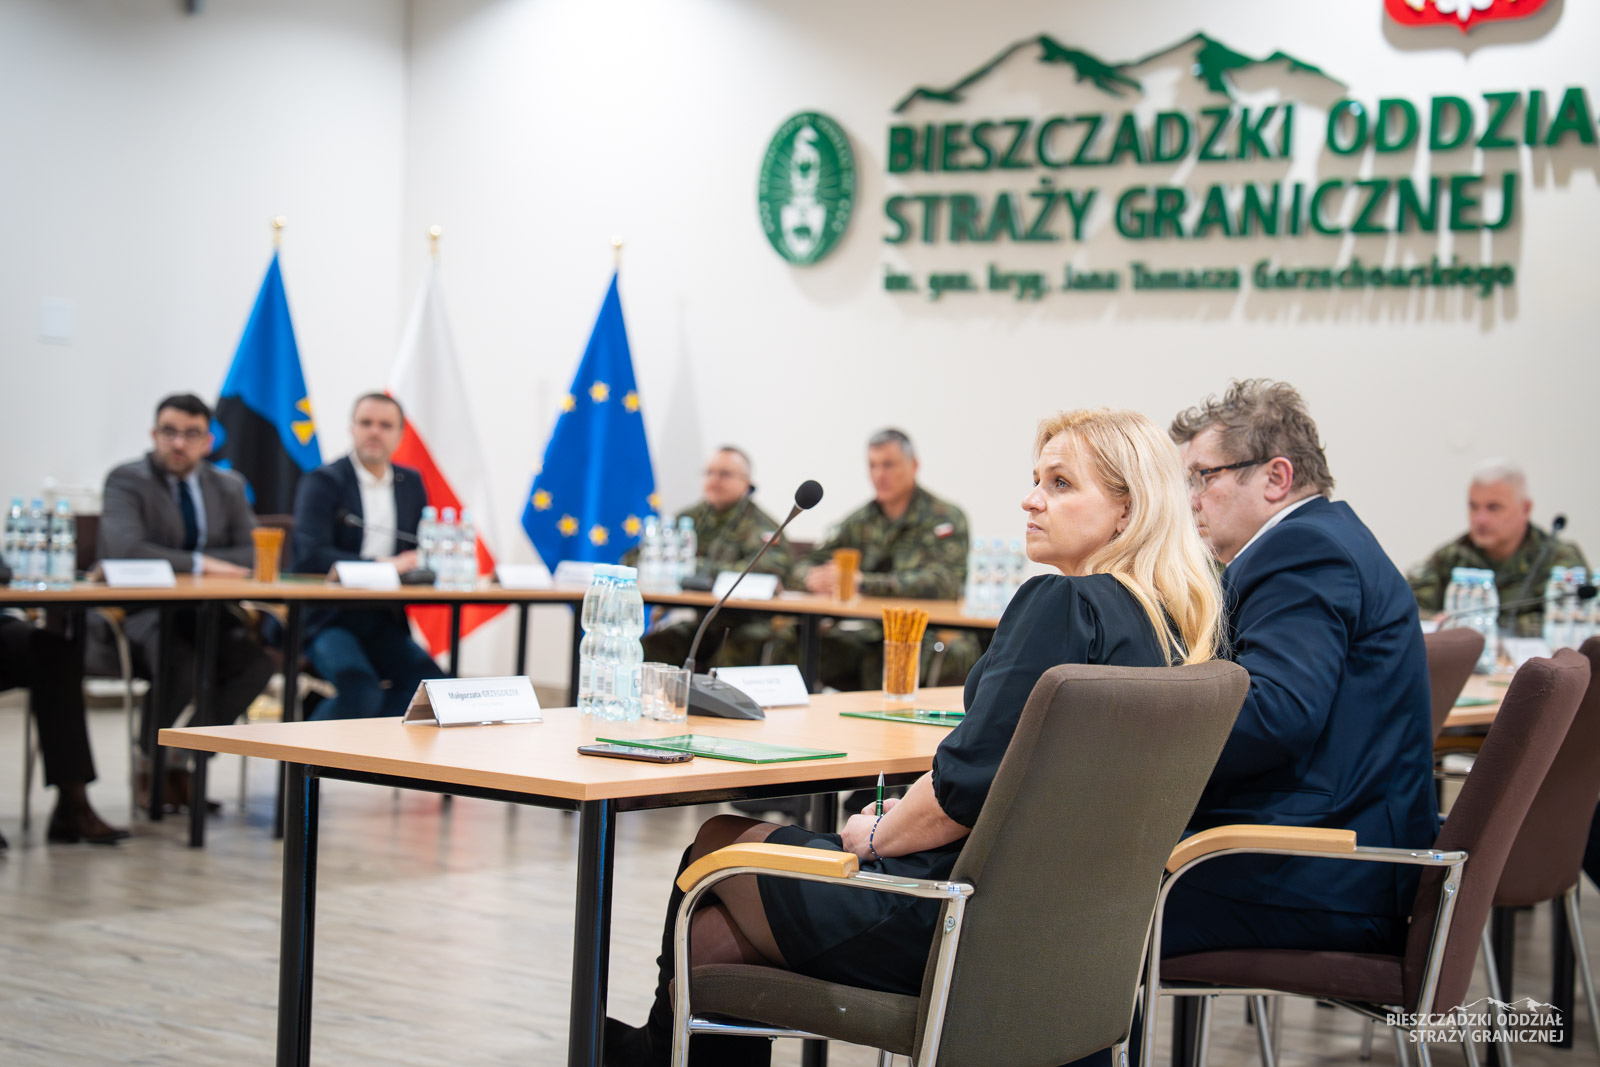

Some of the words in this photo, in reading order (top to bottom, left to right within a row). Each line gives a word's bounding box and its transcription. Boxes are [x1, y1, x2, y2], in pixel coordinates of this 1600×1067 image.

[888, 104, 1294, 174] BIESZCZADZKI
[1326, 87, 1600, 156] ODDZIA
[883, 177, 1098, 244] STRAŻY
[1114, 172, 1517, 240] GRANICZNEJ
